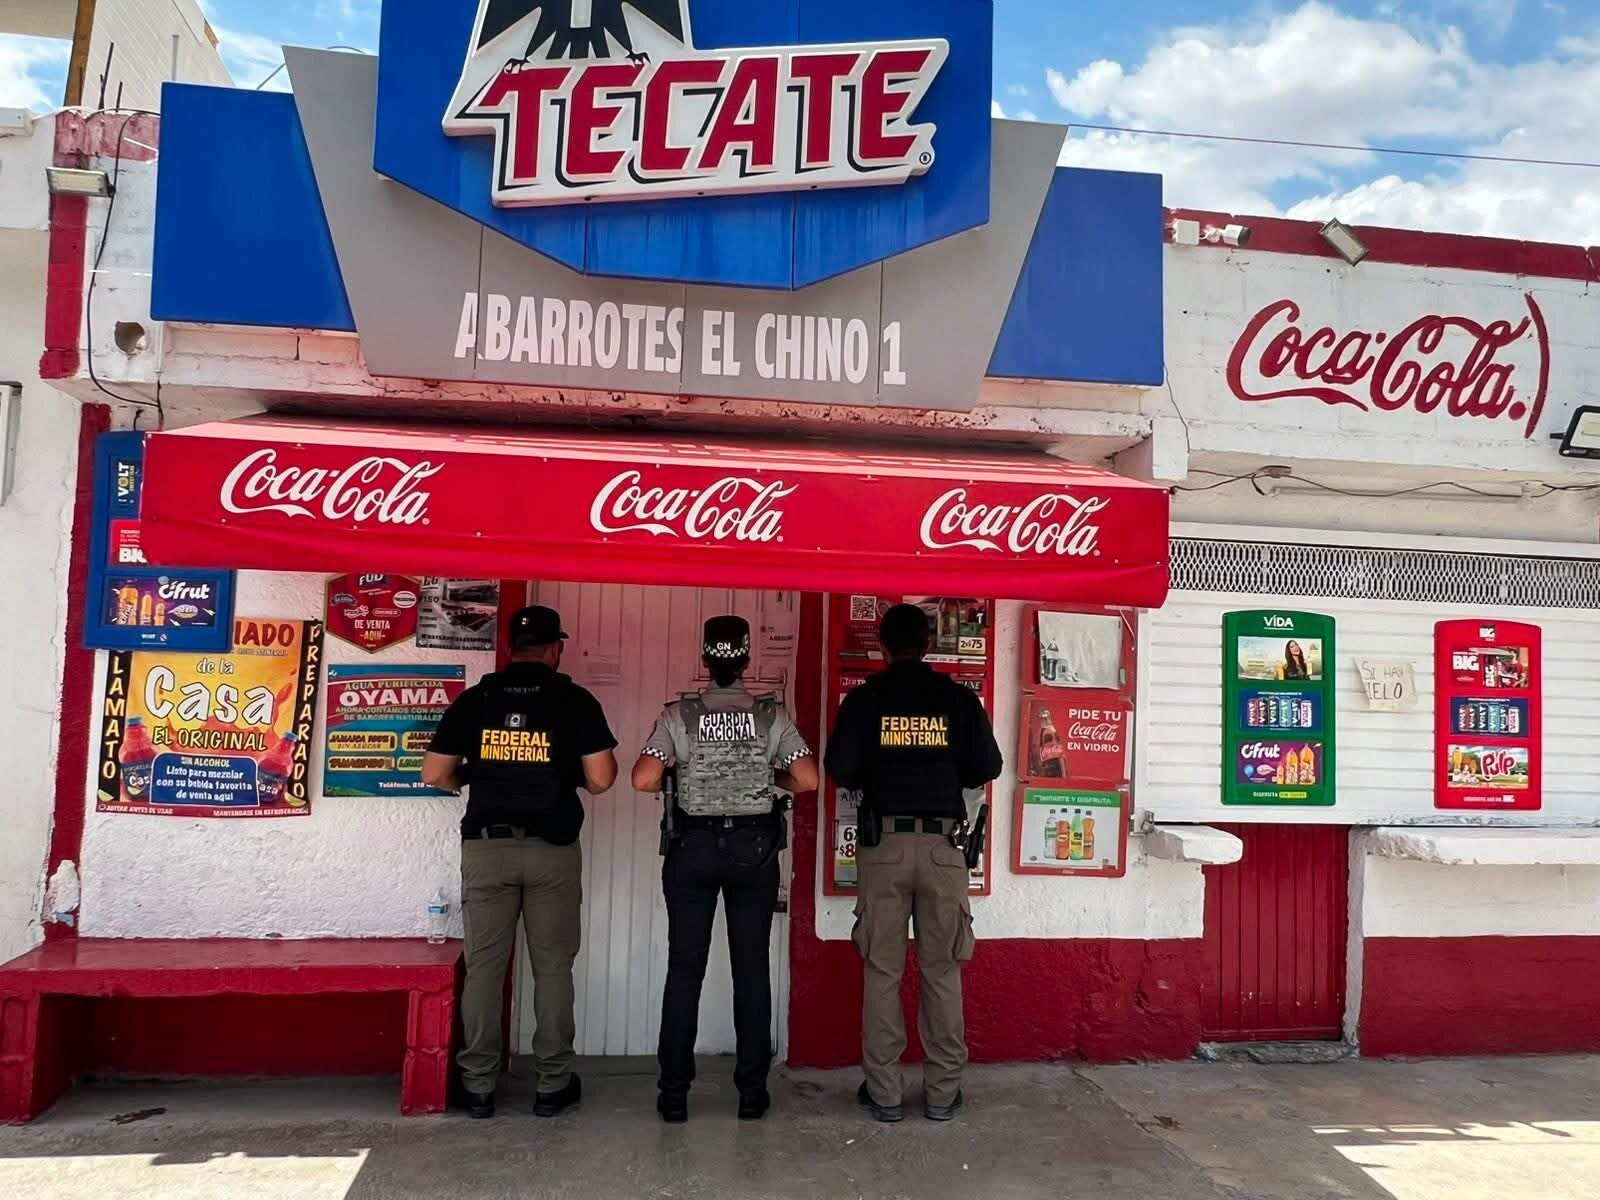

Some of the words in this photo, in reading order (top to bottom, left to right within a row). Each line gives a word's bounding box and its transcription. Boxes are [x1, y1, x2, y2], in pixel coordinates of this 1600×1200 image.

[478, 48, 932, 185] TECATE
[453, 291, 685, 375] ABARROTES
[700, 310, 740, 378] EL
[754, 312, 869, 384] CHINO
[882, 321, 906, 386] 1
[118, 462, 130, 497] VOLT
[219, 448, 445, 525] Coca-Cola
[589, 469, 799, 543] Coca-Cola
[919, 487, 1111, 557] Coca-Cola
[354, 619, 364, 629] DE
[366, 619, 391, 630] VENTA
[716, 642, 731, 651] GN
[196, 658, 216, 674] de
[219, 658, 234, 674] la
[1452, 655, 1480, 671] BIG
[344, 681, 375, 691] AGUA
[1367, 681, 1403, 700] IELO
[145, 665, 275, 726] Casa
[339, 688, 451, 706] OYAMA
[103, 650, 125, 779] LAMATO
[293, 624, 322, 799] PREPARADO
[1068, 708, 1100, 720] PIDE
[1102, 710, 1122, 721] TU
[702, 712, 753, 728] GUARDIA
[881, 716, 948, 731] FEDERAL
[152, 726, 172, 745] EL
[178, 728, 268, 751] ORIGINAL
[481, 729, 550, 748] FEDERAL
[699, 726, 756, 742] NACIONAL
[880, 731, 949, 746] MINISTERIAL
[480, 745, 551, 762] MINISTERIAL
[1067, 741, 1081, 751] EN
[1083, 743, 1120, 753] VIDRIO
[194, 758, 230, 768] ALCOHOL
[1482, 751, 1516, 779] Pulp
[129, 775, 151, 786] Cas
[188, 769, 207, 778] para
[156, 778, 174, 787] con
[257, 780, 279, 795] asa
[176, 789, 187, 799] de
